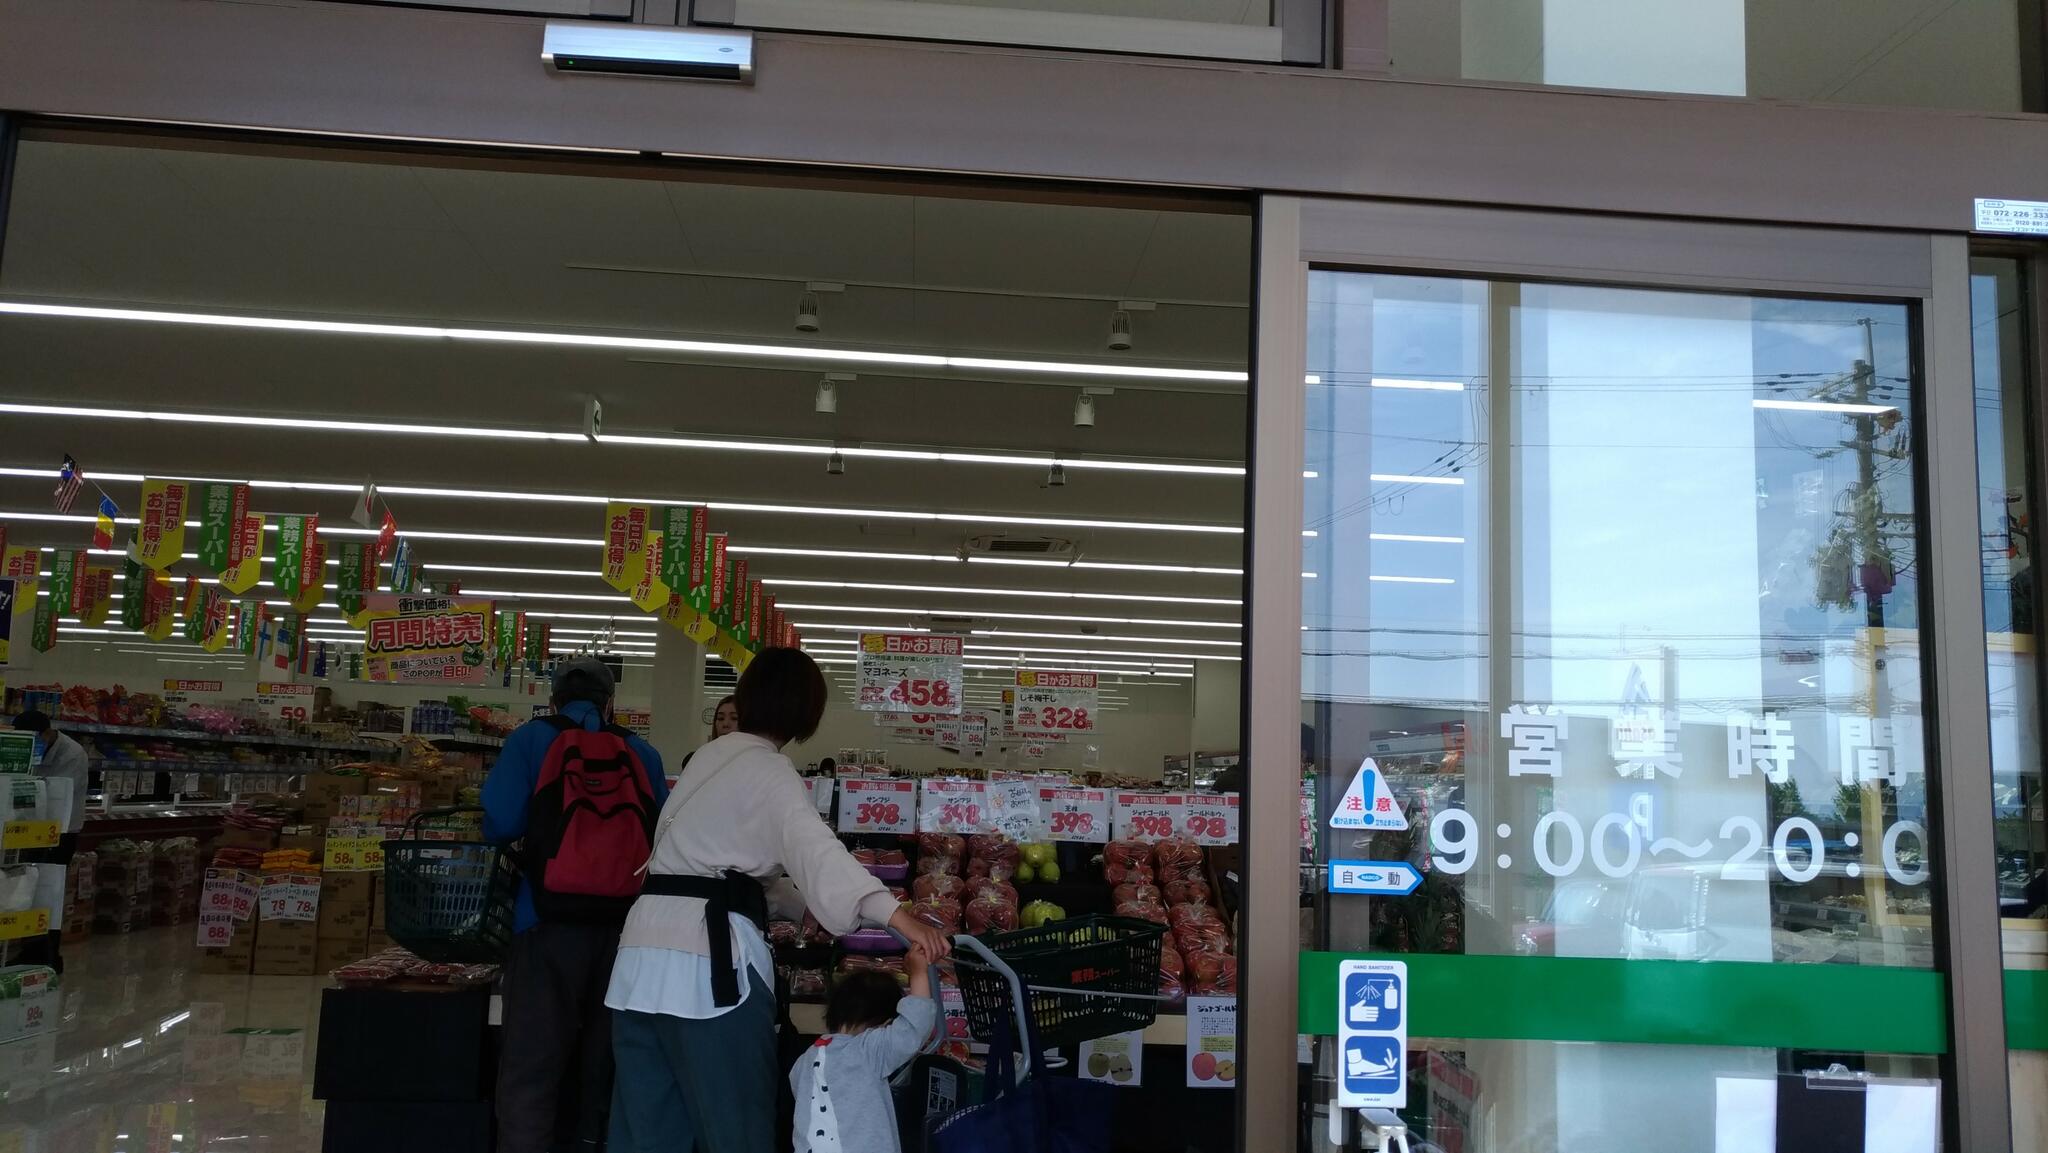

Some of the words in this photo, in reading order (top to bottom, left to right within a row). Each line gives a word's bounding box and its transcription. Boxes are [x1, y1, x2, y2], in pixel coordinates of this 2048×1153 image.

[205, 485, 230, 567] 業務スーパー
[279, 516, 301, 591] 業務スーパー
[667, 508, 689, 593] 業務スーパー
[54, 551, 72, 613] 業務スーパー
[369, 614, 484, 651] 月間特売
[863, 667, 908, 678] マヨネーズ
[1500, 704, 1908, 788] 営業時間
[856, 803, 900, 825] 398
[1050, 811, 1094, 834] 398
